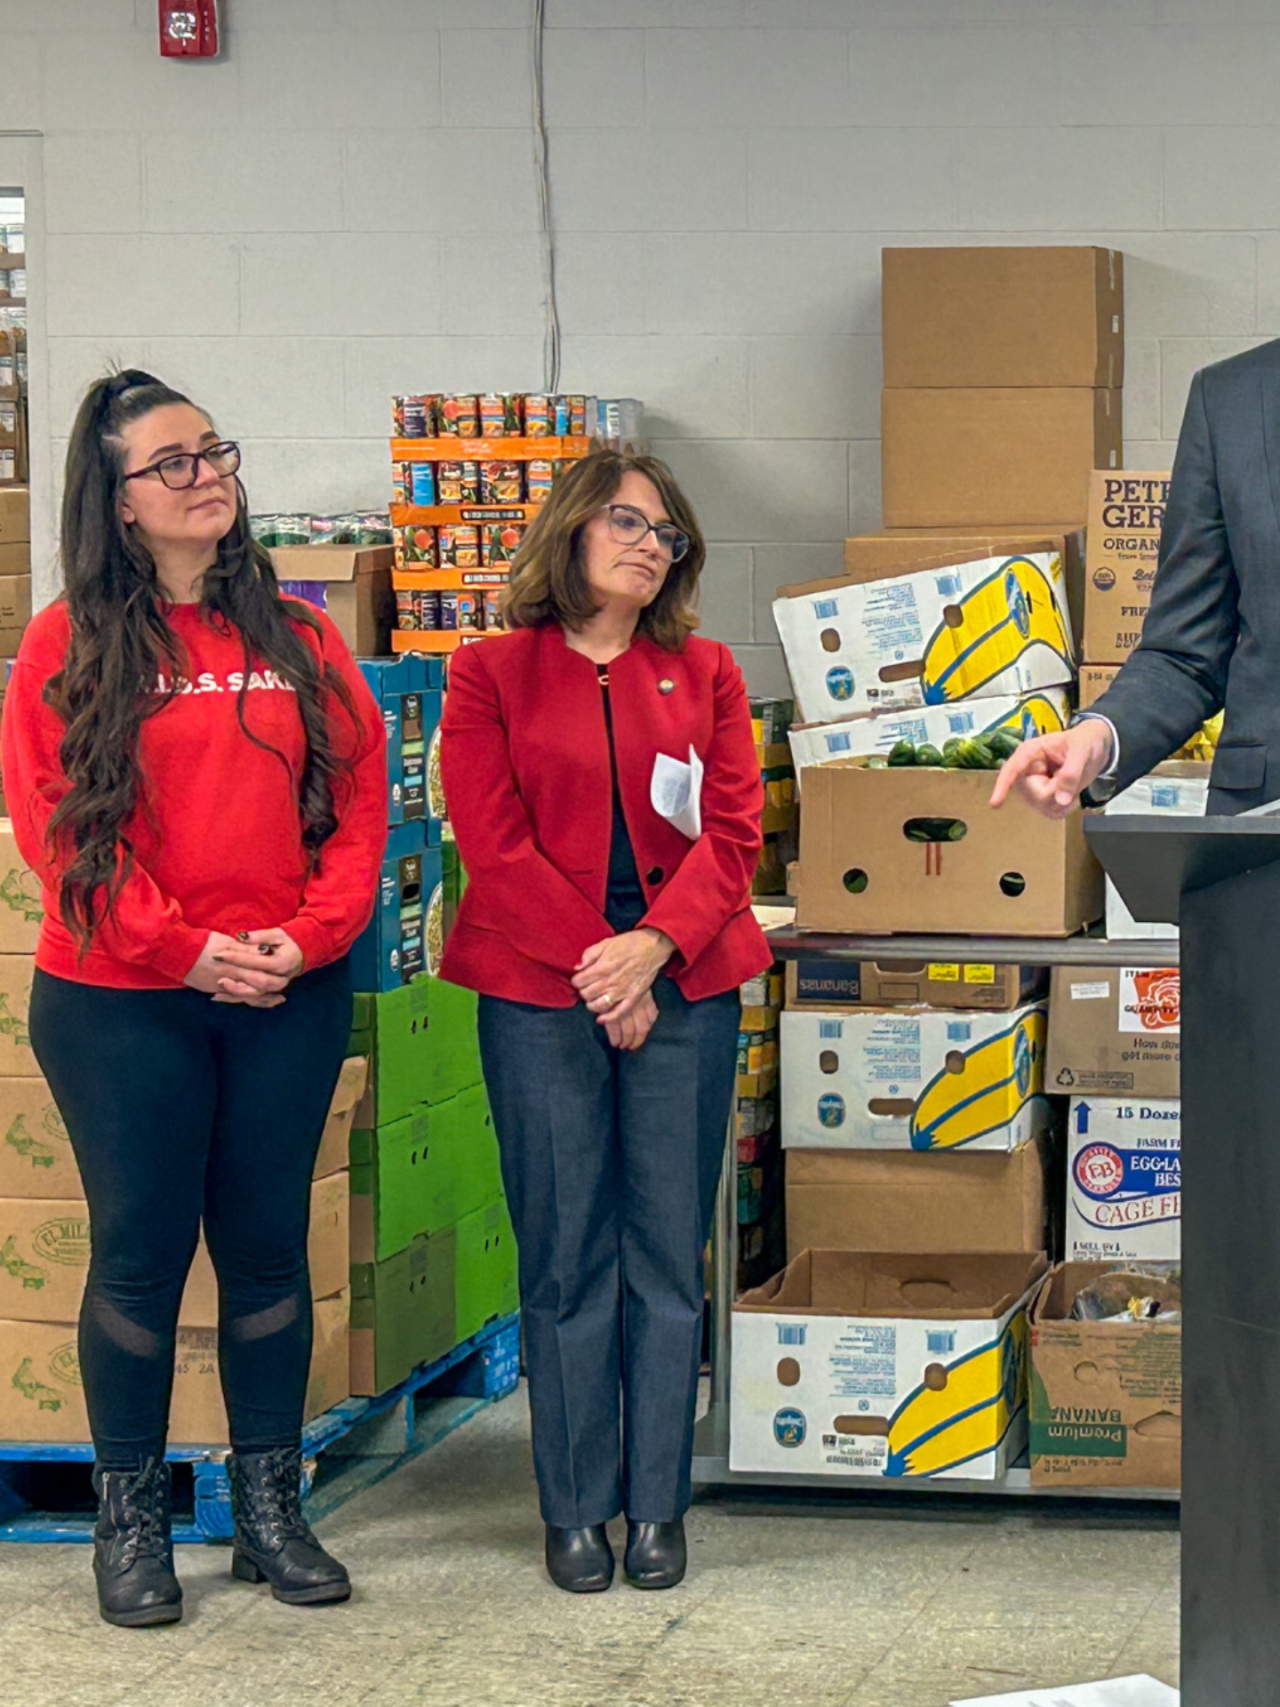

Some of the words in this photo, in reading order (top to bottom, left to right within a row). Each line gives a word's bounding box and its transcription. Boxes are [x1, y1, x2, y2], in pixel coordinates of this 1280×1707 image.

[800, 979, 860, 995] Bananas
[1116, 1106, 1133, 1119] 15
[1139, 1107, 1180, 1120] Doze
[1088, 1161, 1114, 1179] EB
[1095, 1197, 1154, 1224] CAGE
[1048, 1426, 1122, 1442] Premium
